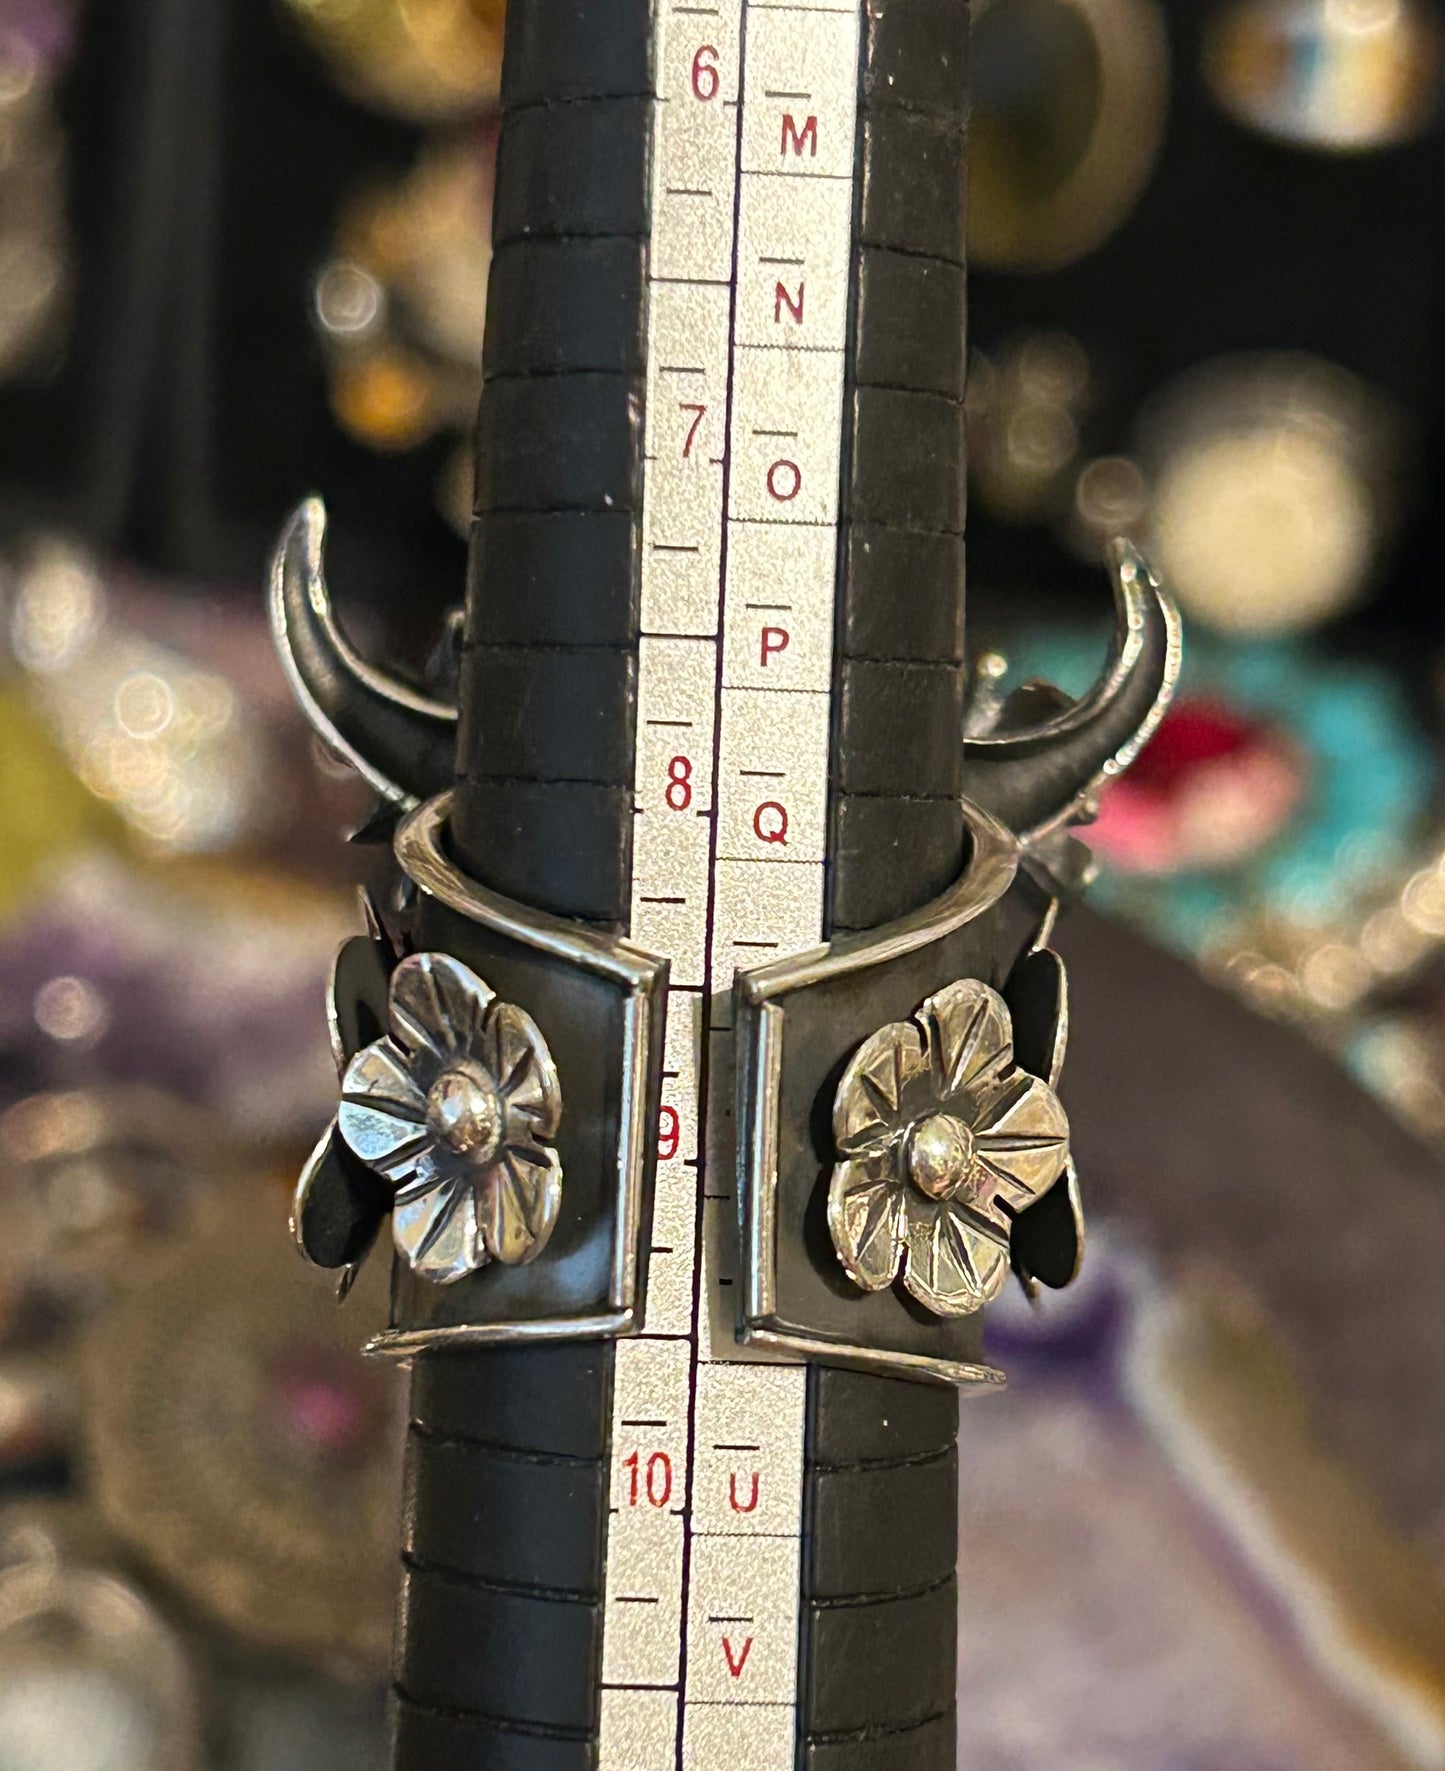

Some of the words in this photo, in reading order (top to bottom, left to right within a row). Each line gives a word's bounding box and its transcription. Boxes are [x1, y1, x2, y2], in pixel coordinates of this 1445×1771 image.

[691, 45, 719, 100] 6
[781, 114, 818, 157] M
[774, 281, 805, 324] N
[679, 403, 706, 458] 7
[766, 459, 801, 501] O
[760, 626, 790, 667] P
[664, 755, 692, 811] 8
[753, 801, 788, 846] Q
[657, 1105, 680, 1160] 9
[621, 1451, 673, 1508] 10
[729, 1471, 760, 1513] U
[722, 1637, 753, 1678] V
